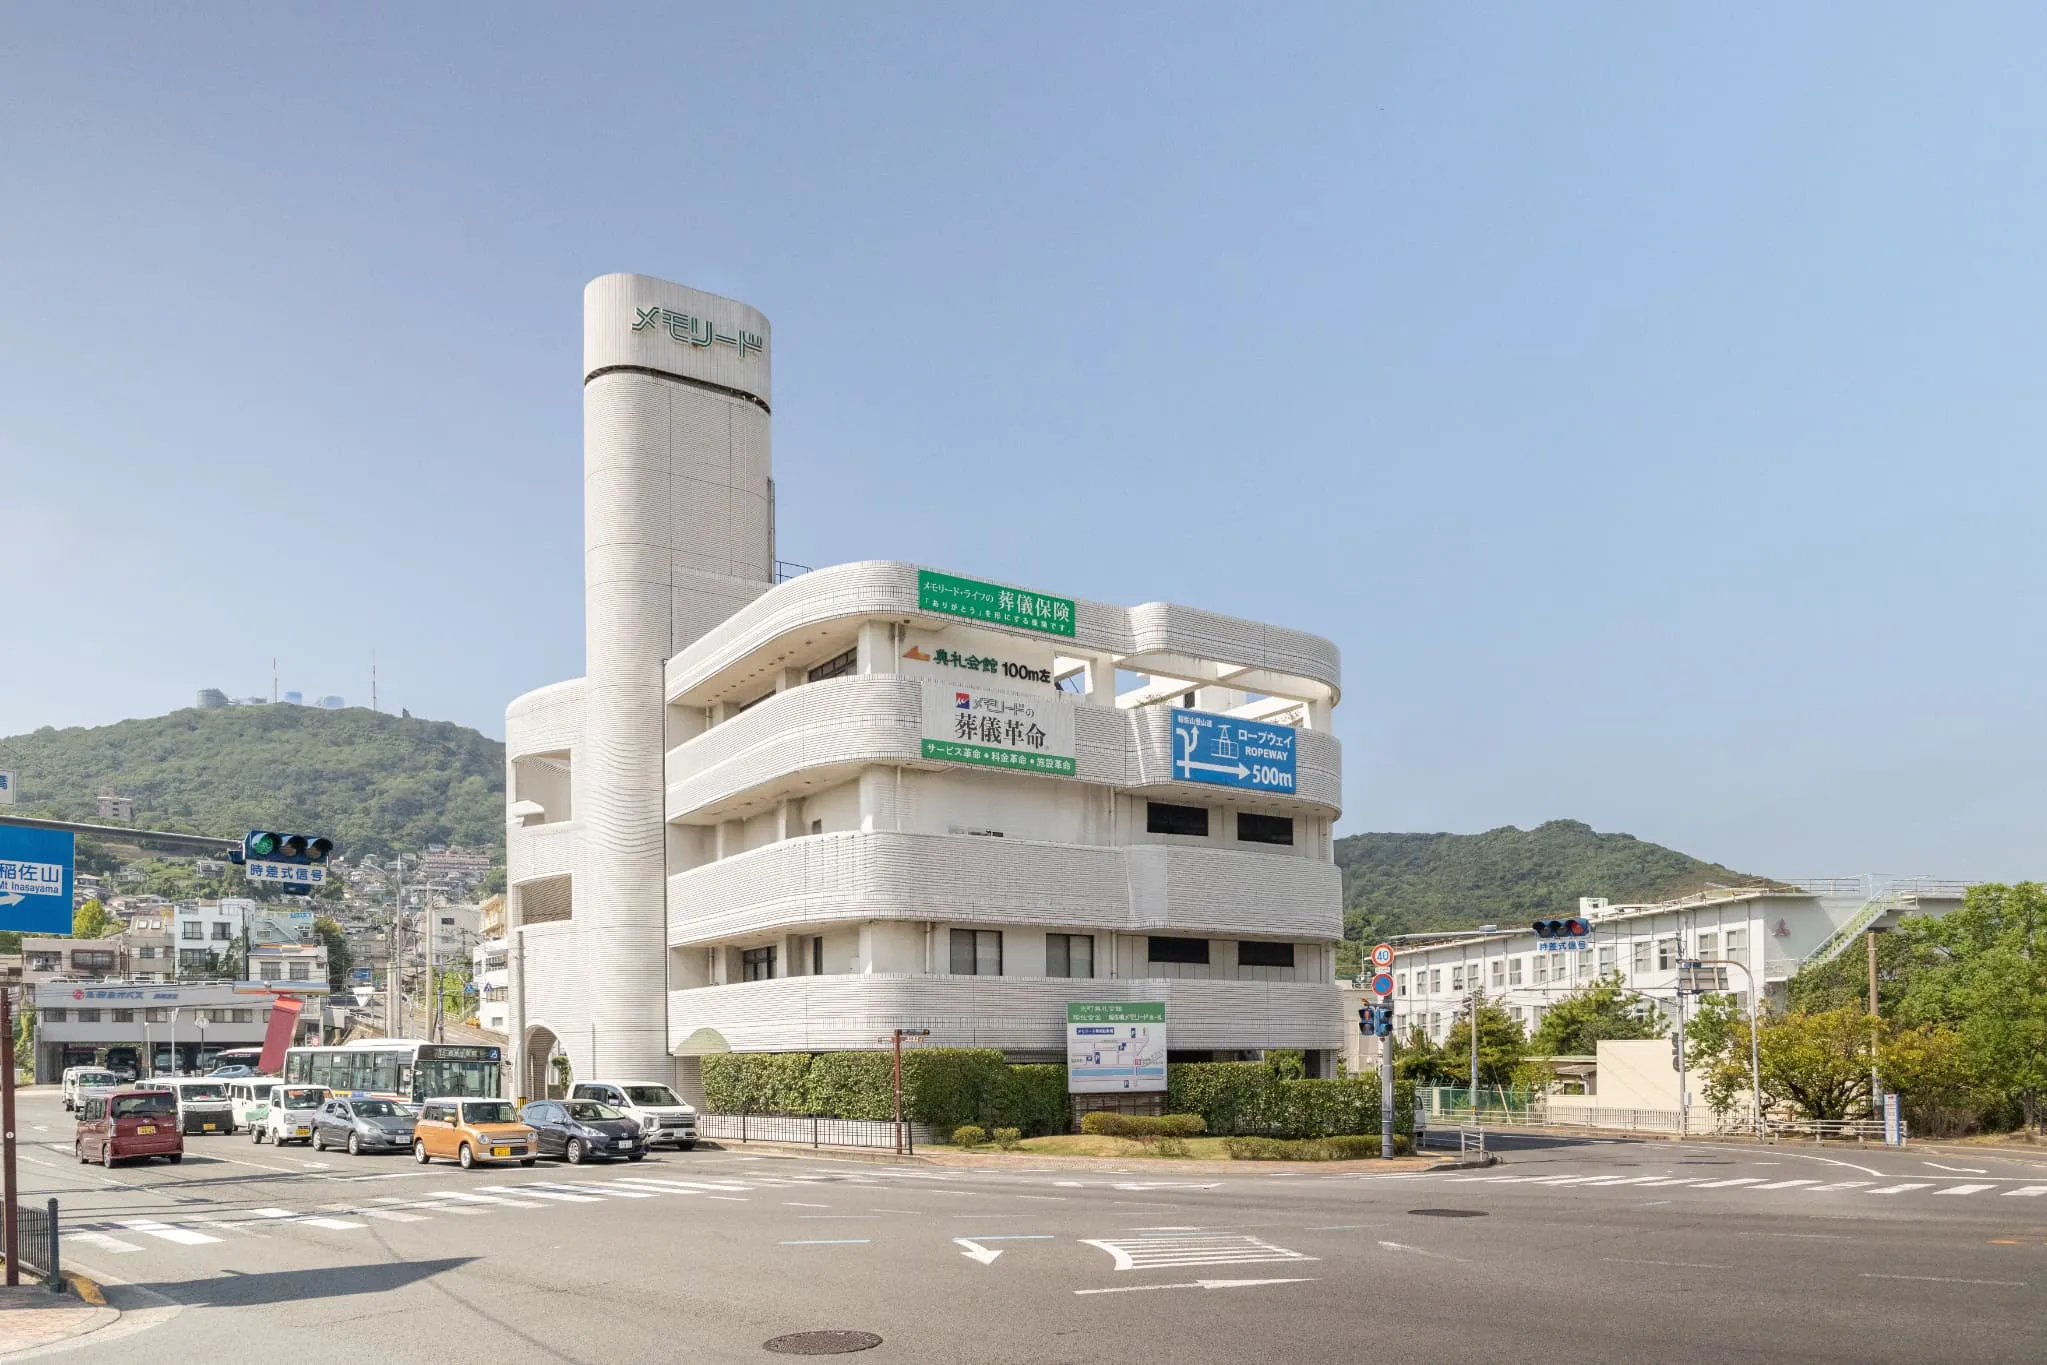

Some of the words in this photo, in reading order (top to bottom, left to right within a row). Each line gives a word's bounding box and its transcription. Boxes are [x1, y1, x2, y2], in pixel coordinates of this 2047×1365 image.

[632, 306, 763, 358] メモリード
[998, 590, 1070, 623] 葬儀保険
[933, 649, 998, 674] 典礼会館
[1002, 662, 1051, 683] 100m左
[972, 697, 1035, 718] メモリードの
[955, 712, 1047, 749] 葬儀革命
[1238, 729, 1293, 748] ロープウェイ
[1245, 746, 1288, 760] ROPEWAY
[1252, 764, 1293, 787] 500m
[0, 863, 59, 882] 稲佐山
[250, 863, 323, 881] 時差式信号
[11, 881, 59, 894] Inasayama
[1376, 950, 1389, 960] 40
